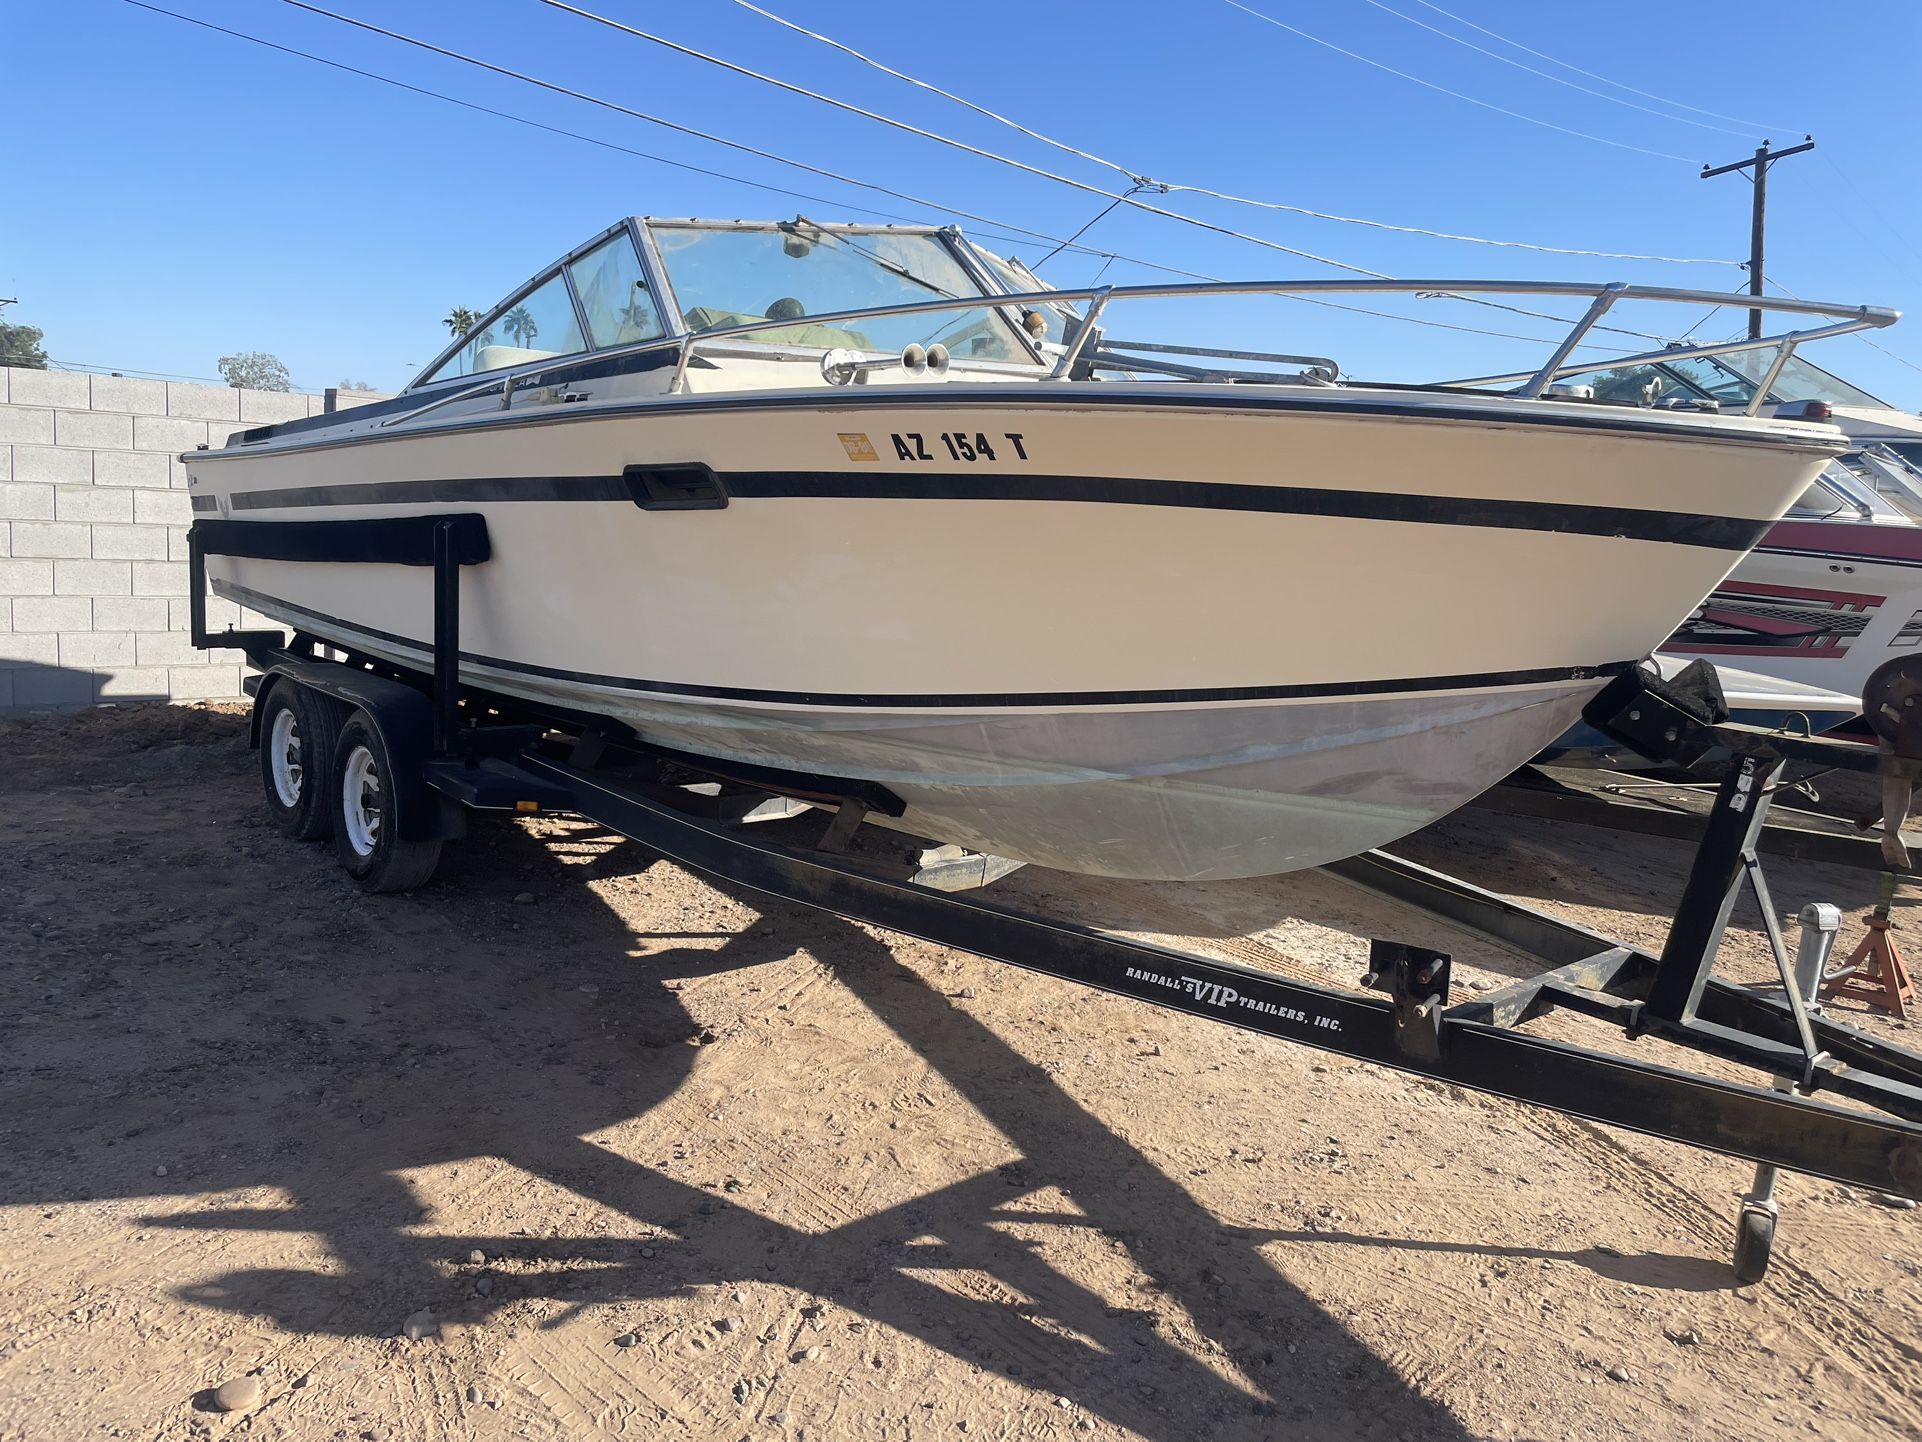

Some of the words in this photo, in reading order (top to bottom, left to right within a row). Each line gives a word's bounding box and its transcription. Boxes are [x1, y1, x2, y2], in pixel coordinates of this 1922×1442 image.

[890, 433, 934, 461] AZ
[940, 432, 997, 462] 154
[1004, 433, 1028, 460] T
[1125, 967, 1194, 993] RANDALL'S
[1180, 975, 1239, 1008] VIP
[1239, 997, 1309, 1024] TRAILERS,
[1314, 1015, 1343, 1032] INC.
